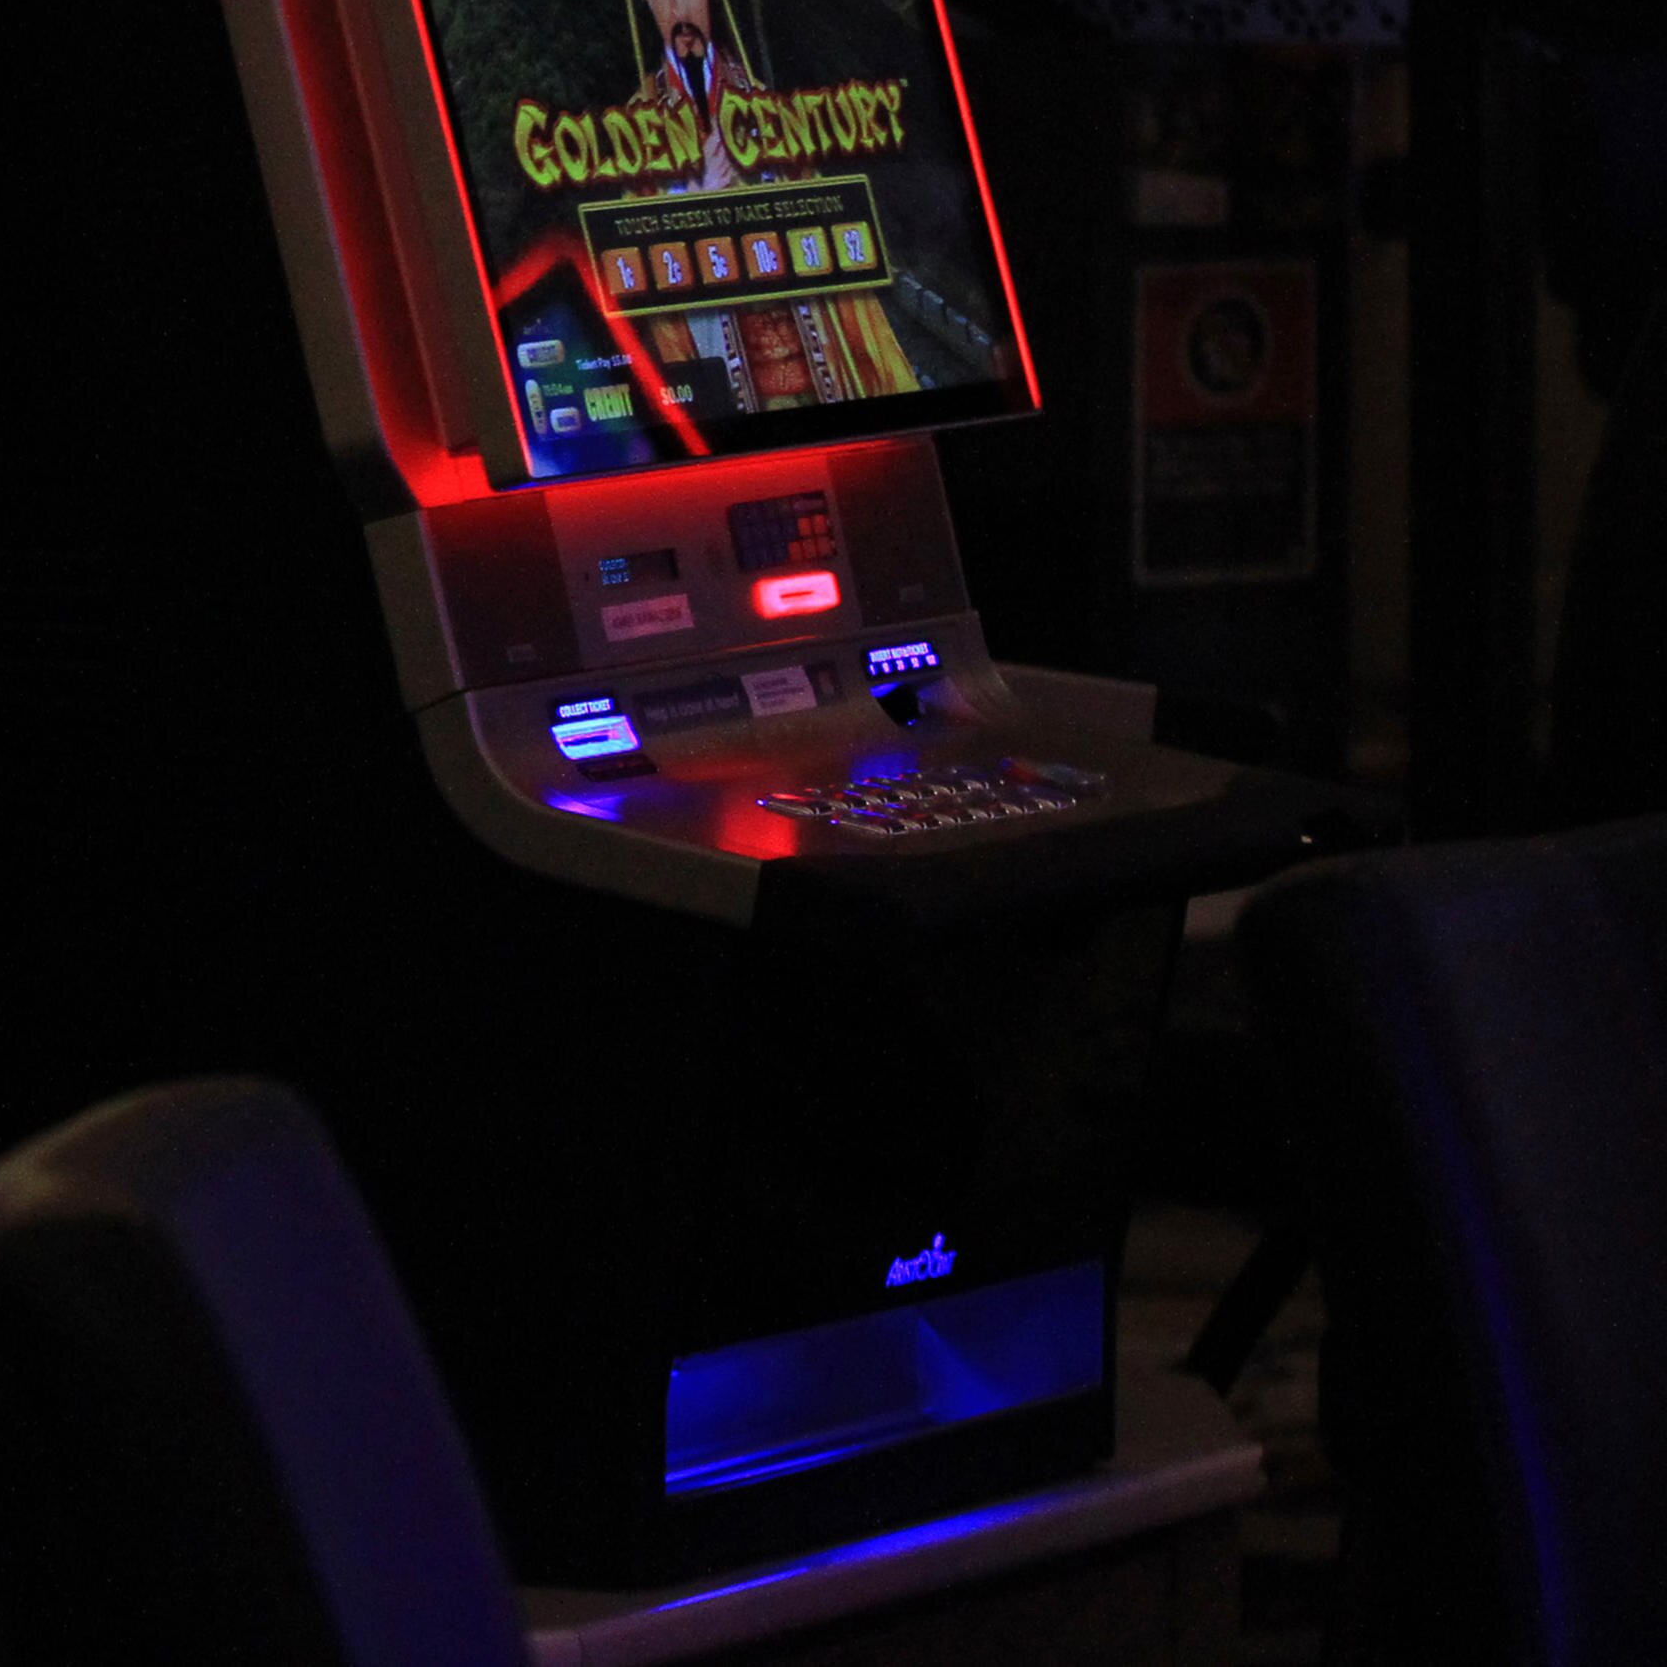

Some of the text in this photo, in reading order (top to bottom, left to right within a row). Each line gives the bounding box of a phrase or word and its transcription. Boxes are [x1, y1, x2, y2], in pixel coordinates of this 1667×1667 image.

[512, 79, 905, 188] GOLDEN CENTURY
[615, 195, 844, 235] TOUCH SCREEN TO MAKE SELECTION
[801, 235, 822, 268] $1
[844, 230, 865, 263] $2
[583, 384, 694, 422] CREDIT $0.00
[559, 698, 612, 718] COLLECT TICKET
